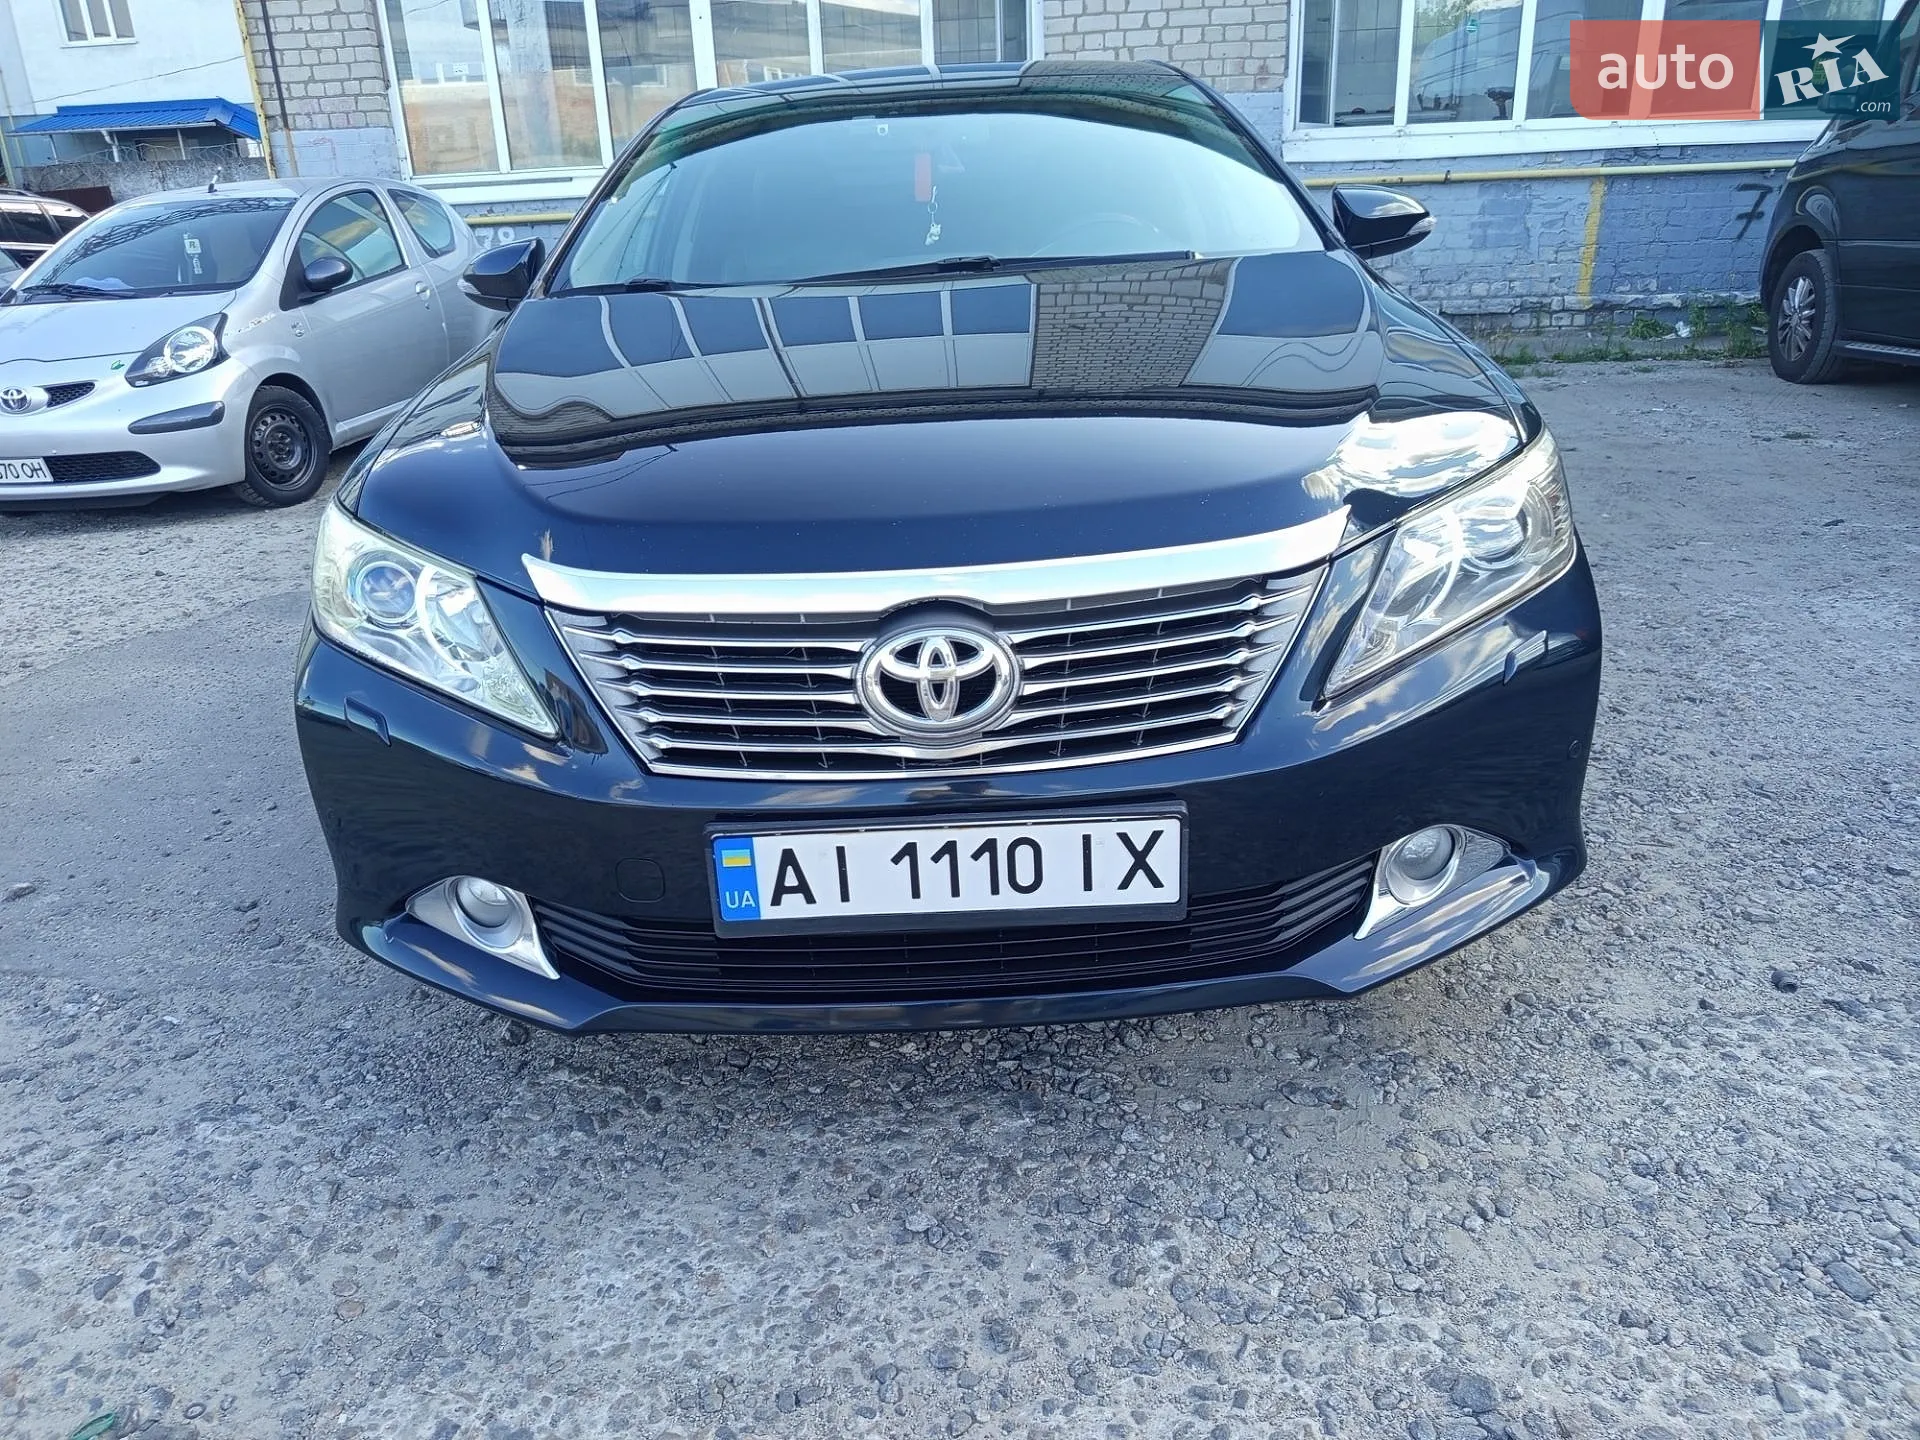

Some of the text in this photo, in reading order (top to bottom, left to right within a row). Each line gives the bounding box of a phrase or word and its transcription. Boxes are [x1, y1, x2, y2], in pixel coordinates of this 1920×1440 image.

[1734, 183, 1774, 240] 7
[21, 461, 47, 479] OH
[770, 829, 1165, 906] AI 1110 IX
[725, 890, 756, 908] UA
